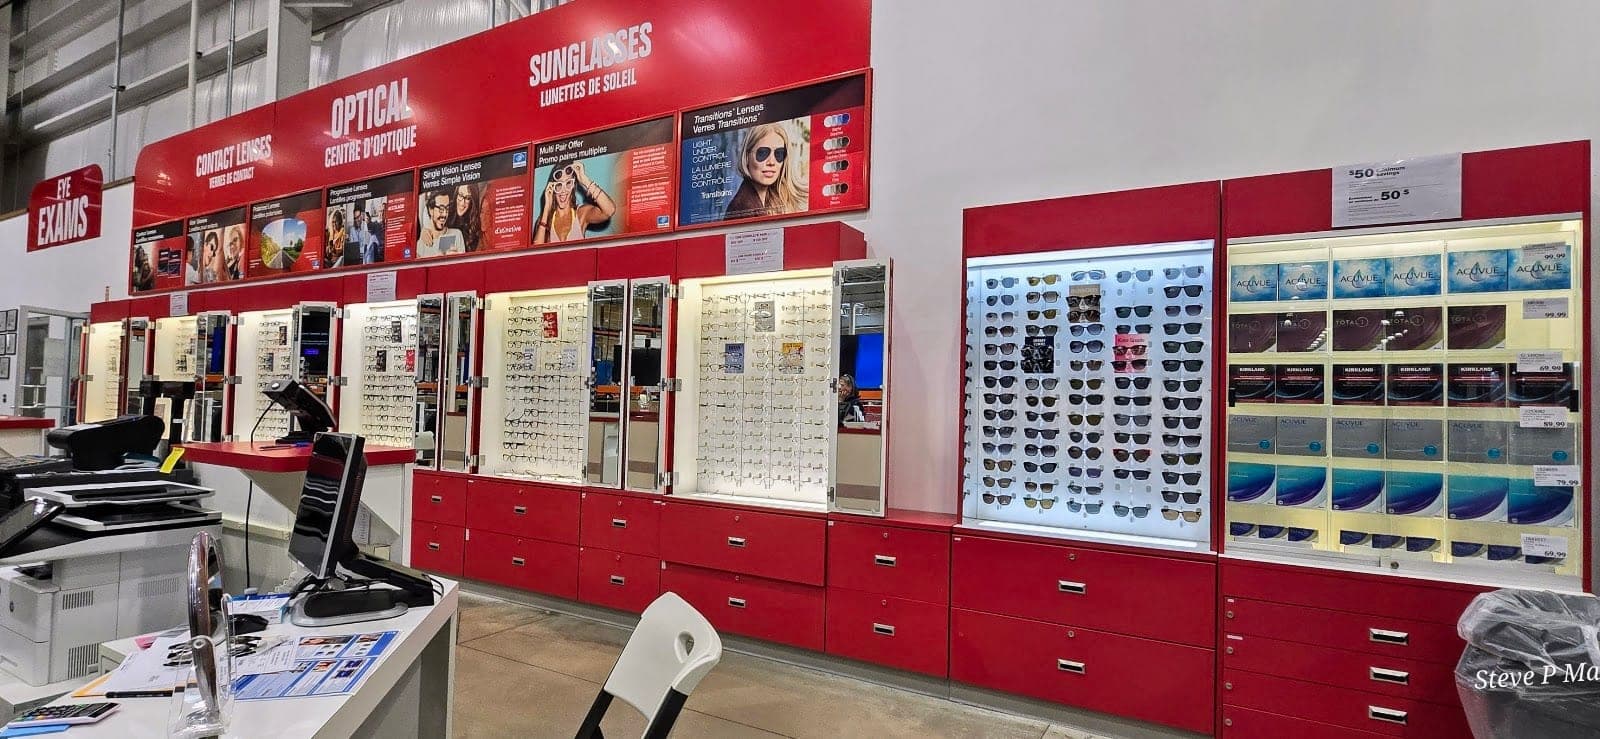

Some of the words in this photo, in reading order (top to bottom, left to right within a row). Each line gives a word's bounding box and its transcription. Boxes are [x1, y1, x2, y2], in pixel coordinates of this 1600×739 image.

[529, 21, 653, 87] SUNGLASSES
[540, 80, 586, 108] LUNETTES
[588, 77, 601, 96] DE
[603, 67, 637, 92] SOLEIL
[331, 77, 412, 139] OPTICAL
[736, 103, 764, 116] Lenses
[693, 123, 716, 134] Verres
[196, 145, 235, 178] CONTACT
[236, 134, 272, 166] LENSES
[324, 140, 361, 168] CENTRE
[363, 125, 417, 156] D'OPTIQUE
[539, 146, 554, 155] Multi
[555, 143, 567, 151] Pair
[568, 139, 584, 149] Offer
[539, 156, 558, 165] Promo
[559, 150, 578, 163] paires
[579, 145, 608, 158] multiples
[423, 169, 440, 180] Single
[441, 166, 459, 176] Vision
[460, 161, 482, 172] Lenses
[440, 175, 461, 186] Simple
[462, 172, 481, 182] Vision
[56, 176, 72, 200] EYE
[37, 195, 89, 246] EXAMS
[1393, 271, 1434, 281] ACUVUE
[1456, 265, 1500, 276] ACUVUE
[1516, 262, 1563, 273] ACUVUE
[1340, 274, 1378, 283] ACUVUE
